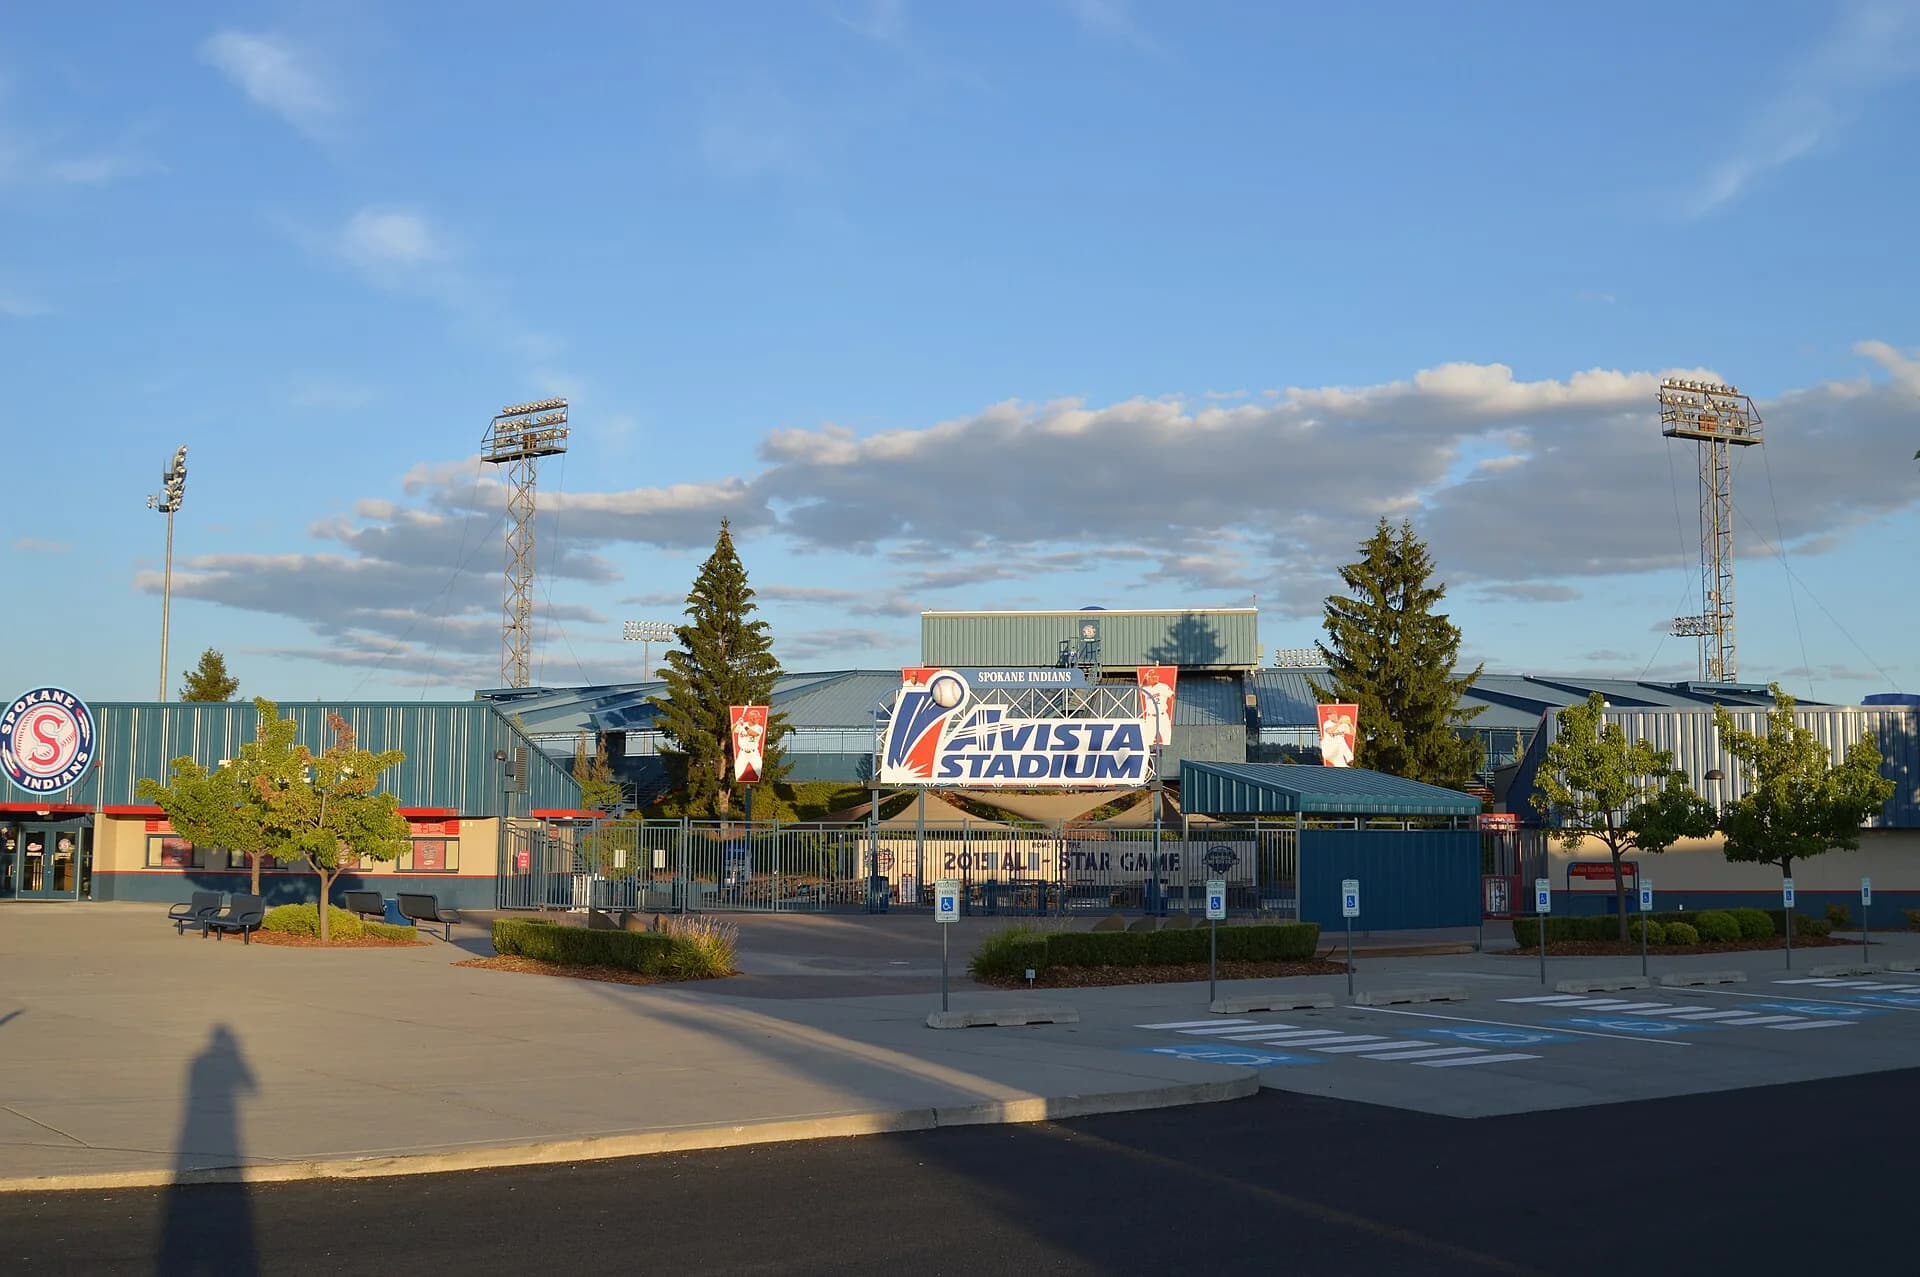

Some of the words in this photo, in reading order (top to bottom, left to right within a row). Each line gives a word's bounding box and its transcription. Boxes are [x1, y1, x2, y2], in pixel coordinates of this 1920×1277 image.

[978, 671, 1025, 683] SPOKANE
[1028, 671, 1072, 683] INDIANS
[1, 690, 76, 735] SPOKANE
[943, 709, 1144, 751] AVISTA
[28, 714, 65, 766] S
[23, 751, 88, 790] INDIANS
[937, 754, 1144, 779] STADIUM
